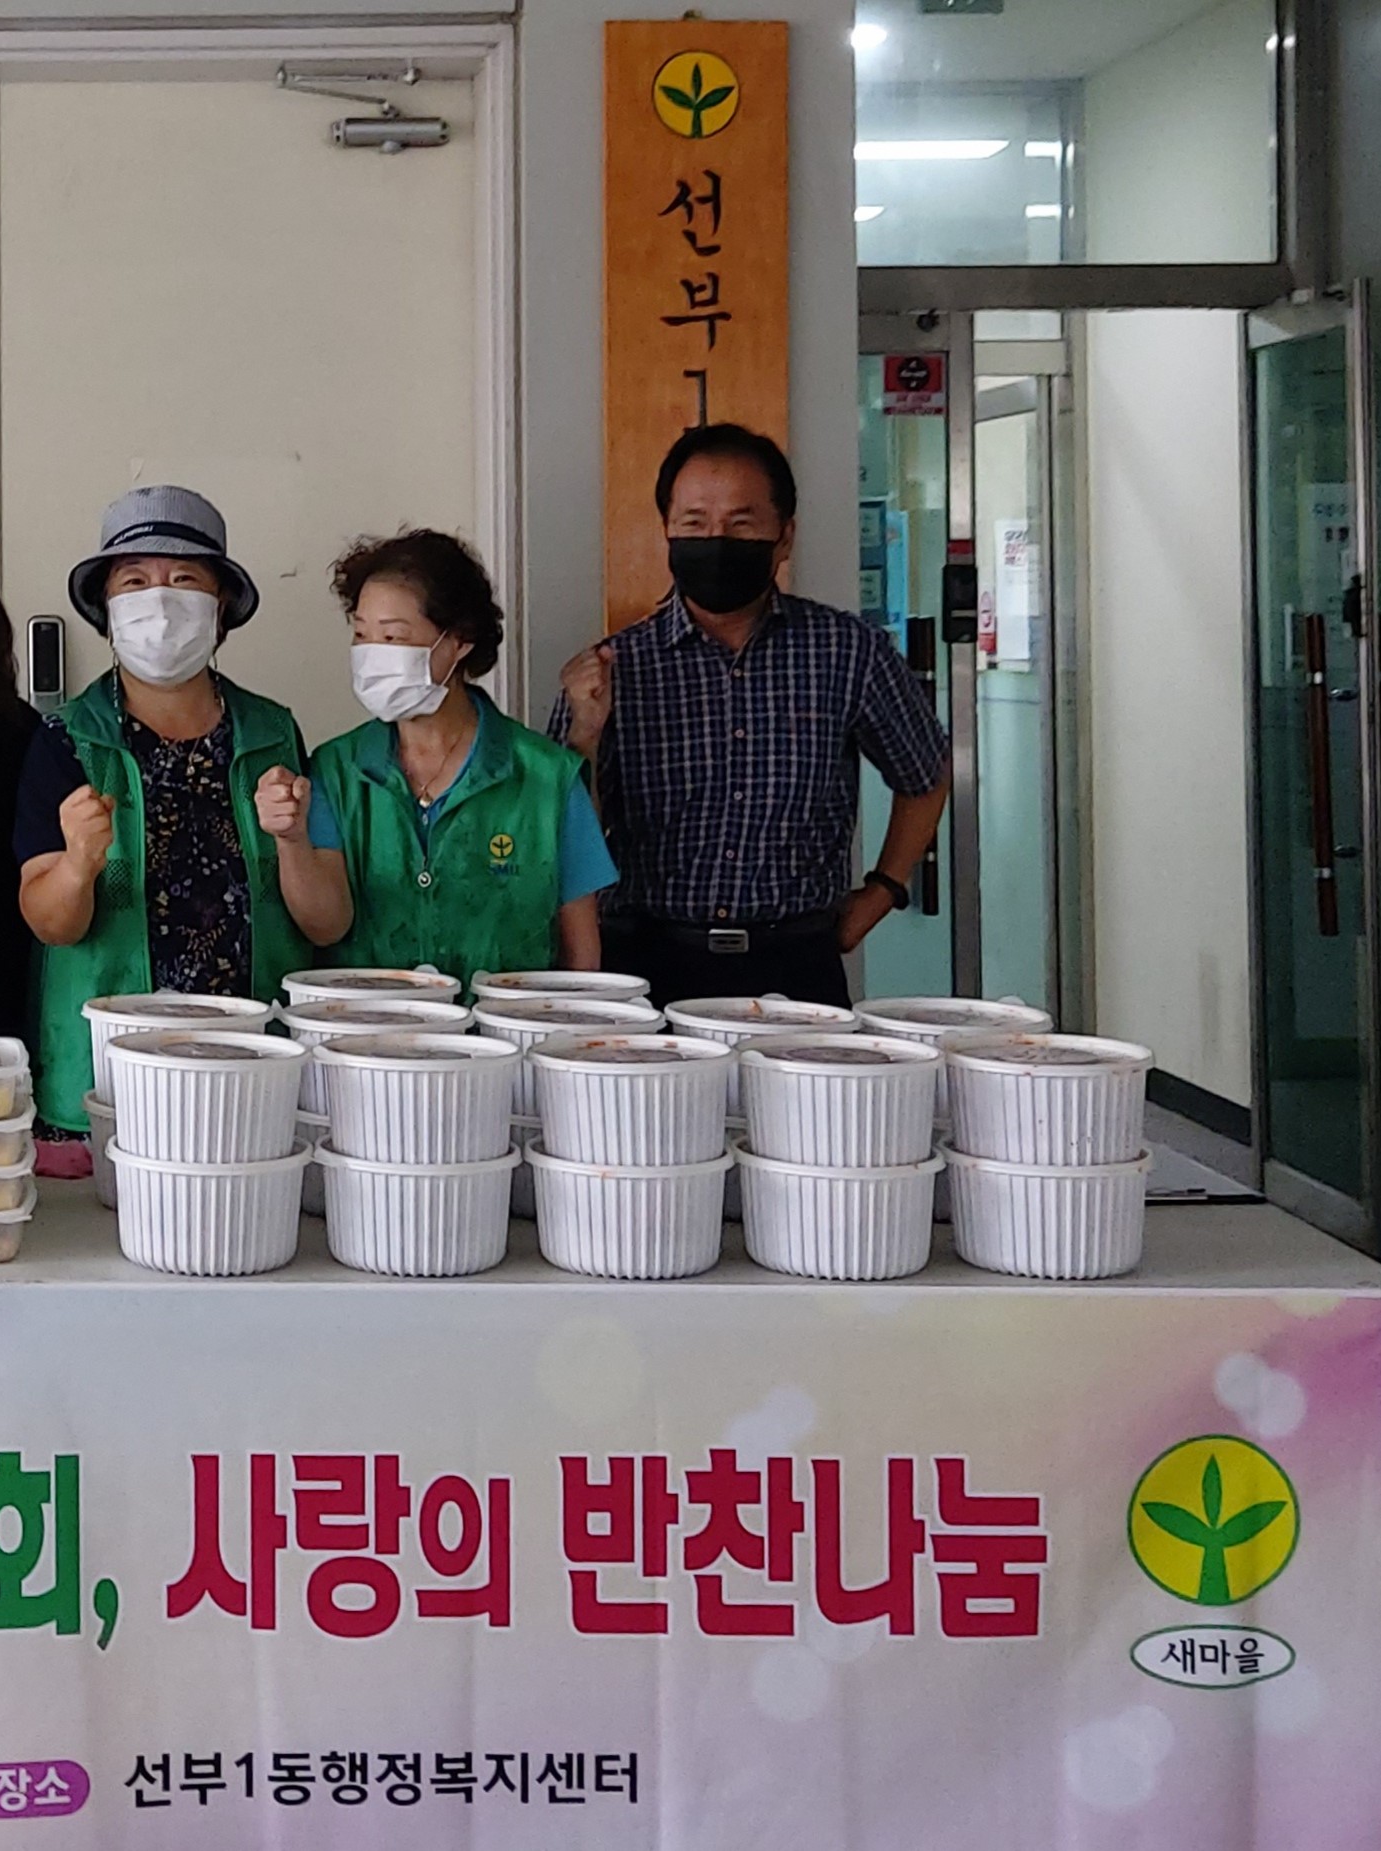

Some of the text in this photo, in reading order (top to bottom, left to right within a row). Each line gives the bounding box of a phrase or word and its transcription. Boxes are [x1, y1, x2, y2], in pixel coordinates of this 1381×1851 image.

[166, 1453, 511, 1638] 사랑의
[560, 1448, 1048, 1638] 반찬나눔
[1160, 1636, 1266, 1676] 새마을
[124, 1751, 640, 1809] 선부1동행정복지센터
